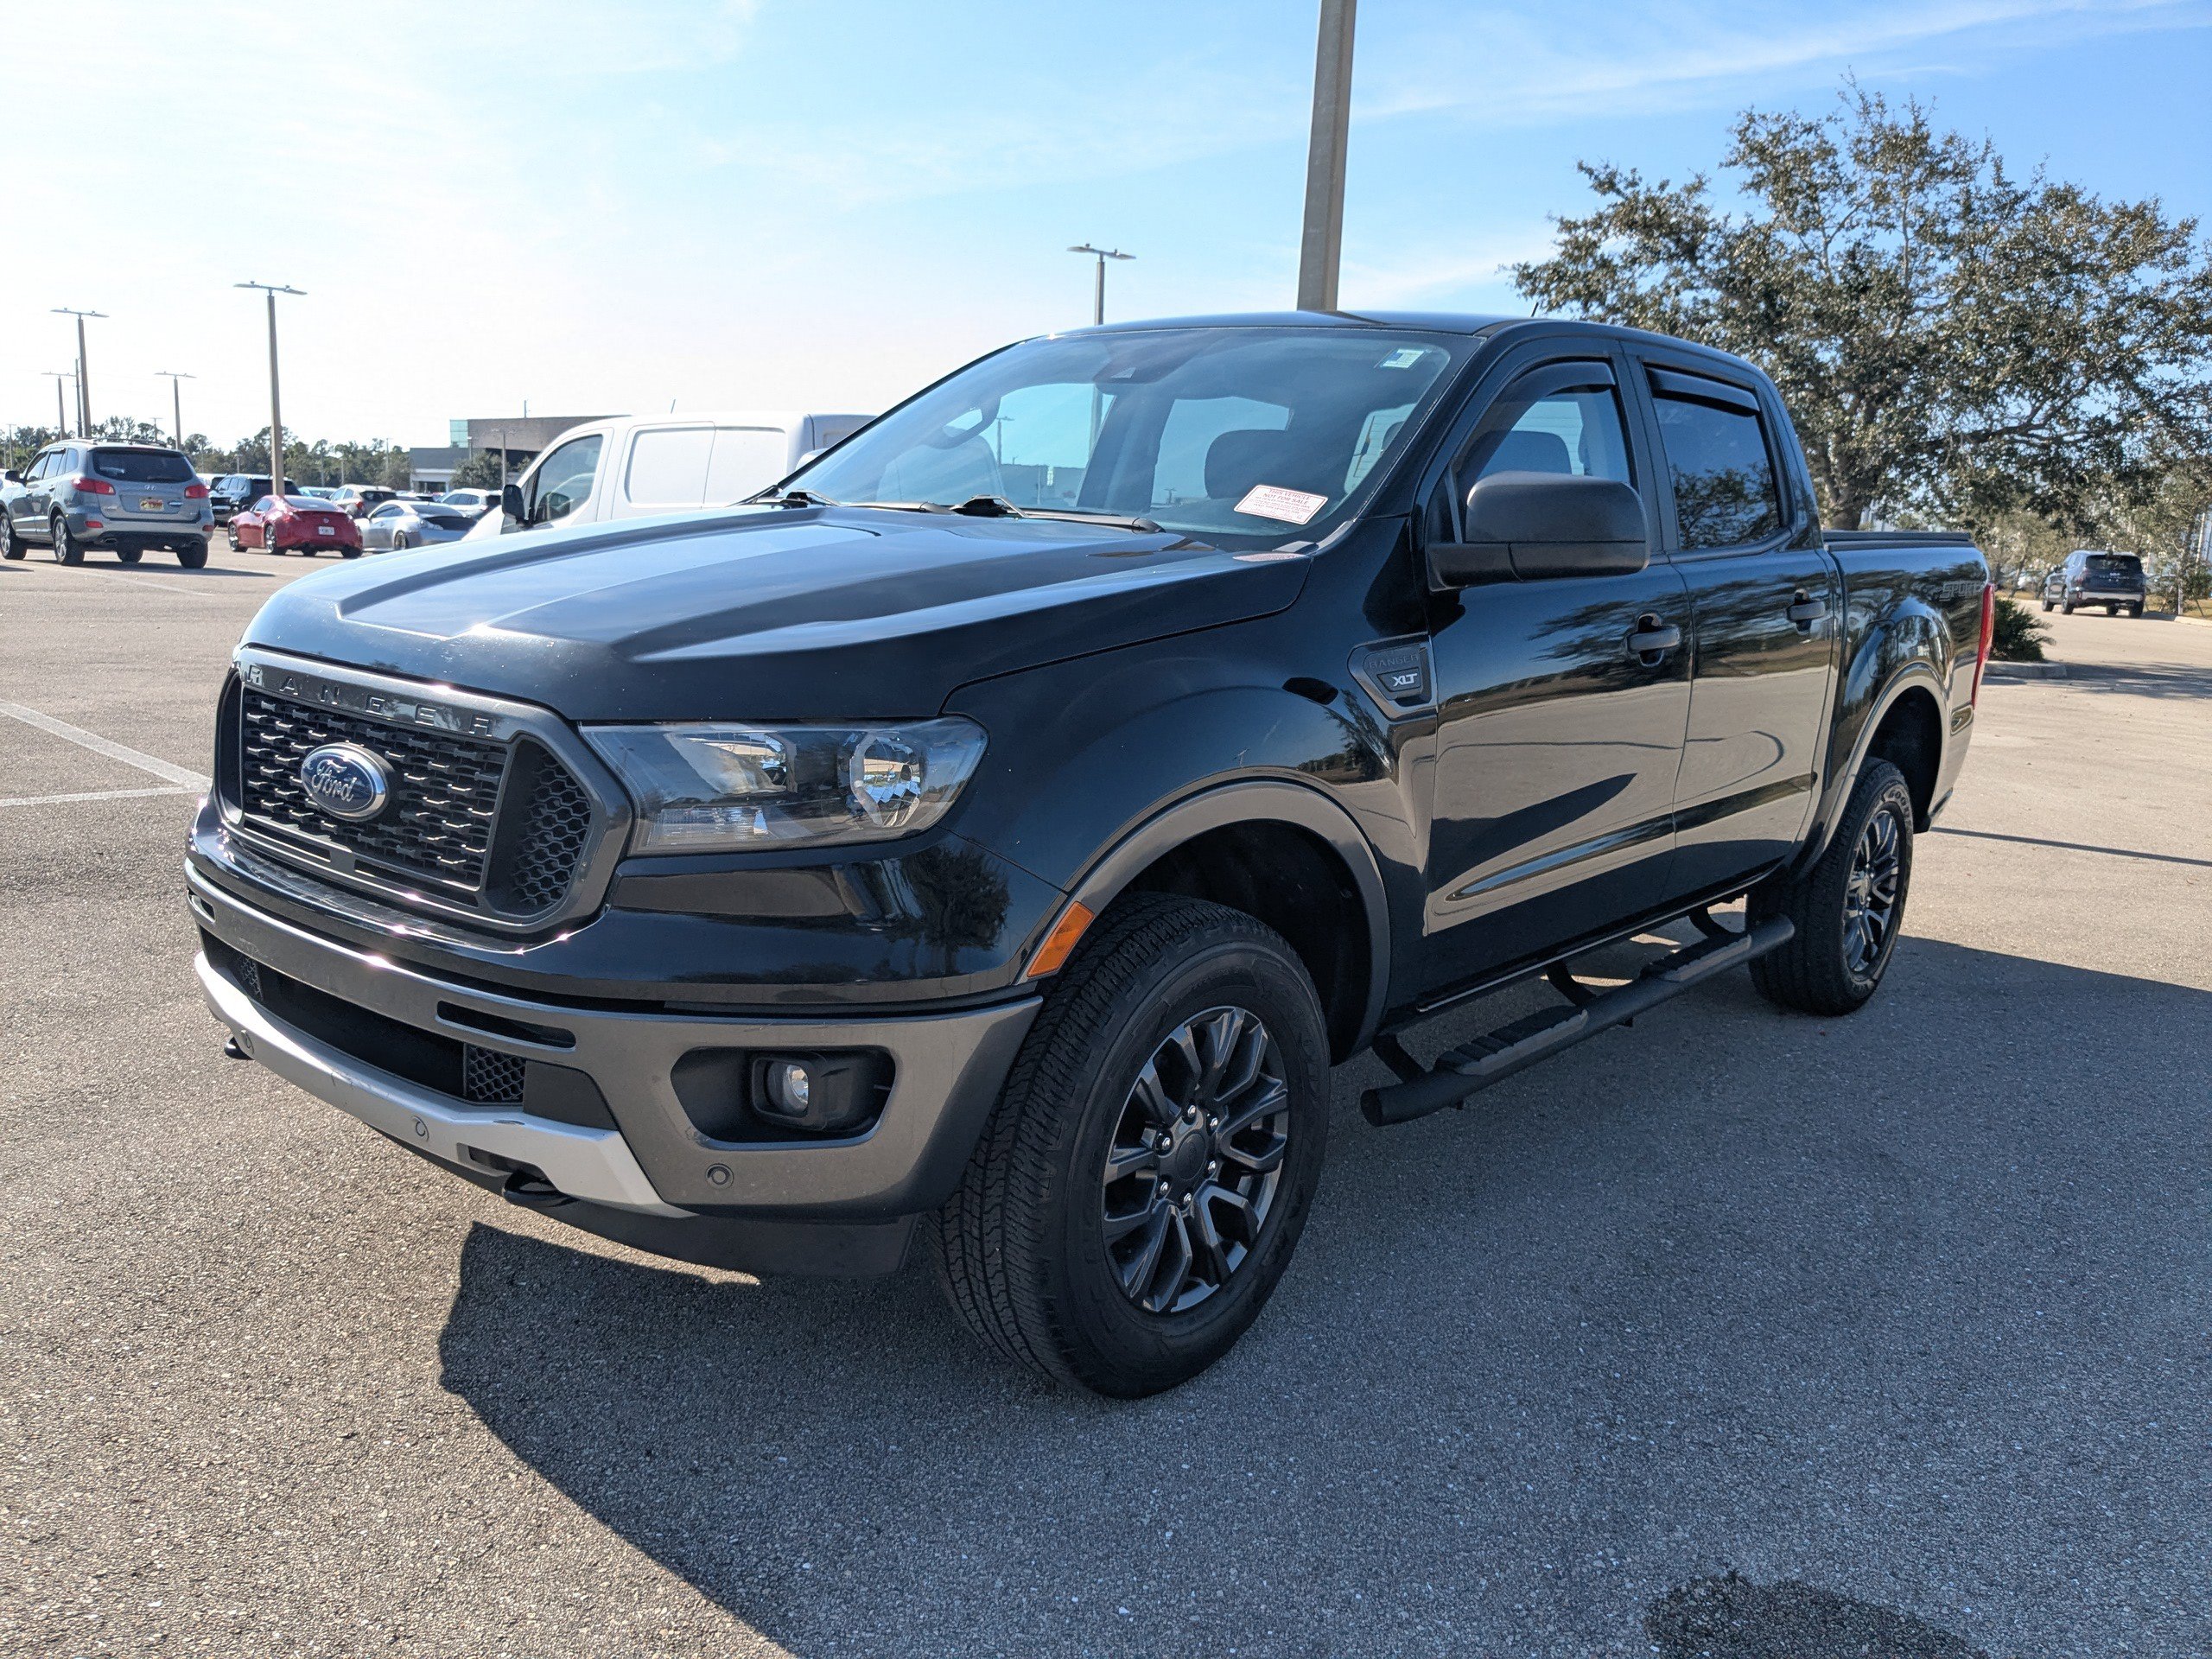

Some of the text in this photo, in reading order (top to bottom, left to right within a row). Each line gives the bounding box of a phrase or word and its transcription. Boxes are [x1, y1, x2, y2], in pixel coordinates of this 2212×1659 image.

[1284, 491, 1311, 500] VEHICLE
[1369, 654, 1419, 669] RANGER
[1391, 672, 1418, 687] XLT
[247, 664, 493, 737] RANGER
[311, 759, 358, 803] Ford
